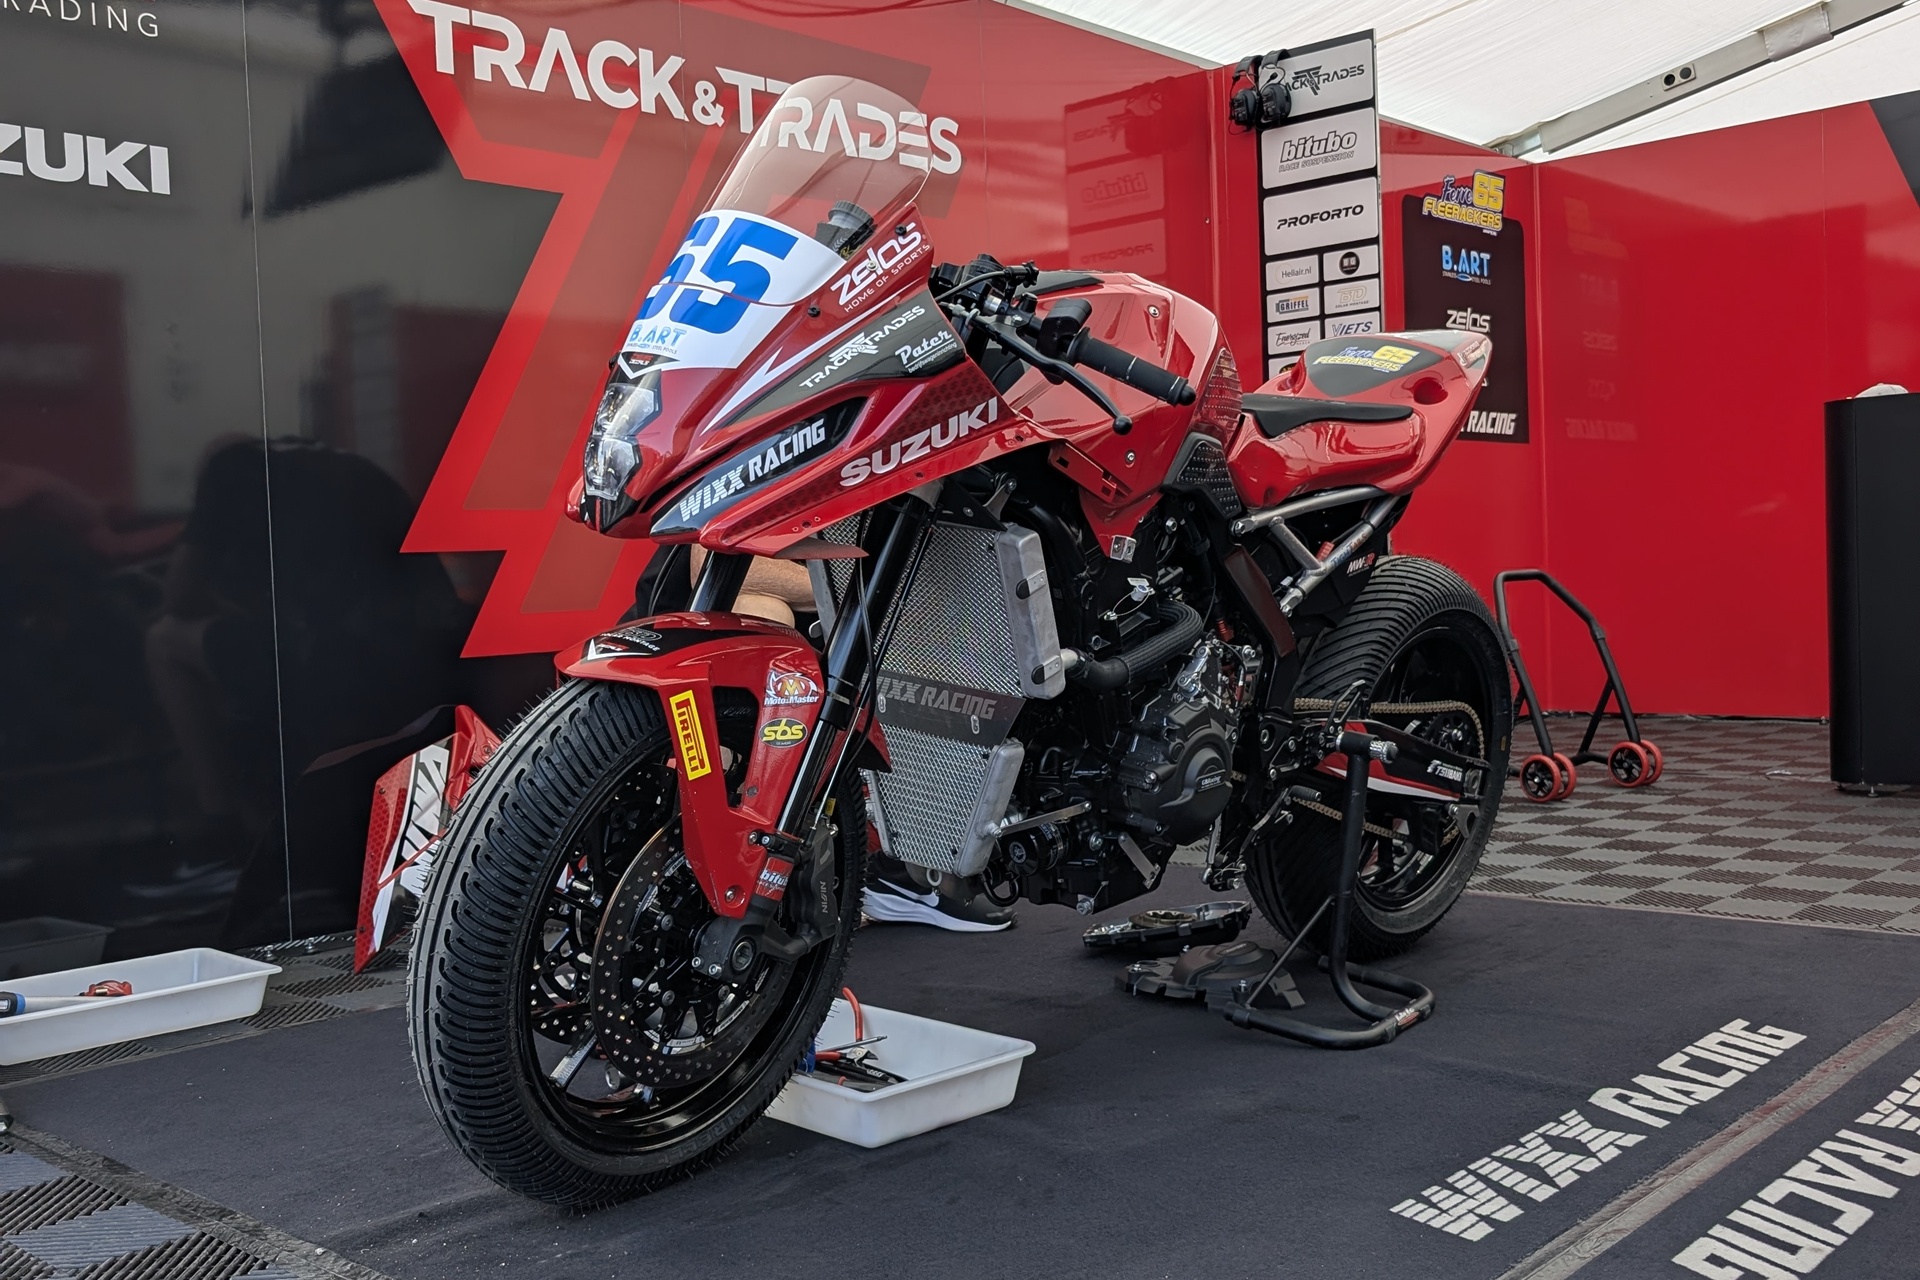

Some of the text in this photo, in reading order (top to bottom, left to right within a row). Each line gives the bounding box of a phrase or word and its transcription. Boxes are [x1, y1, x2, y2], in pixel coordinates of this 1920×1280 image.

[1280, 130, 1358, 163] bitubo
[1472, 171, 1505, 212] 65
[1276, 204, 1365, 230] PROFORTO
[1422, 195, 1503, 232] FLEERACKERS
[844, 243, 930, 313] HOME OF SPORTS
[1442, 245, 1491, 277] B.ART
[1280, 299, 1309, 311] GRIFFEL
[894, 329, 954, 366] Pater
[1332, 321, 1373, 337] VIETS
[839, 395, 998, 487] SUZUKI
[1467, 410, 1518, 435] RACING
[679, 417, 826, 523] WIXX RACING
[920, 685, 998, 720] RACING
[674, 697, 706, 772] PIRELLI
[1389, 1109, 1647, 1242] WIXX
[1588, 1017, 1808, 1129] RACING
